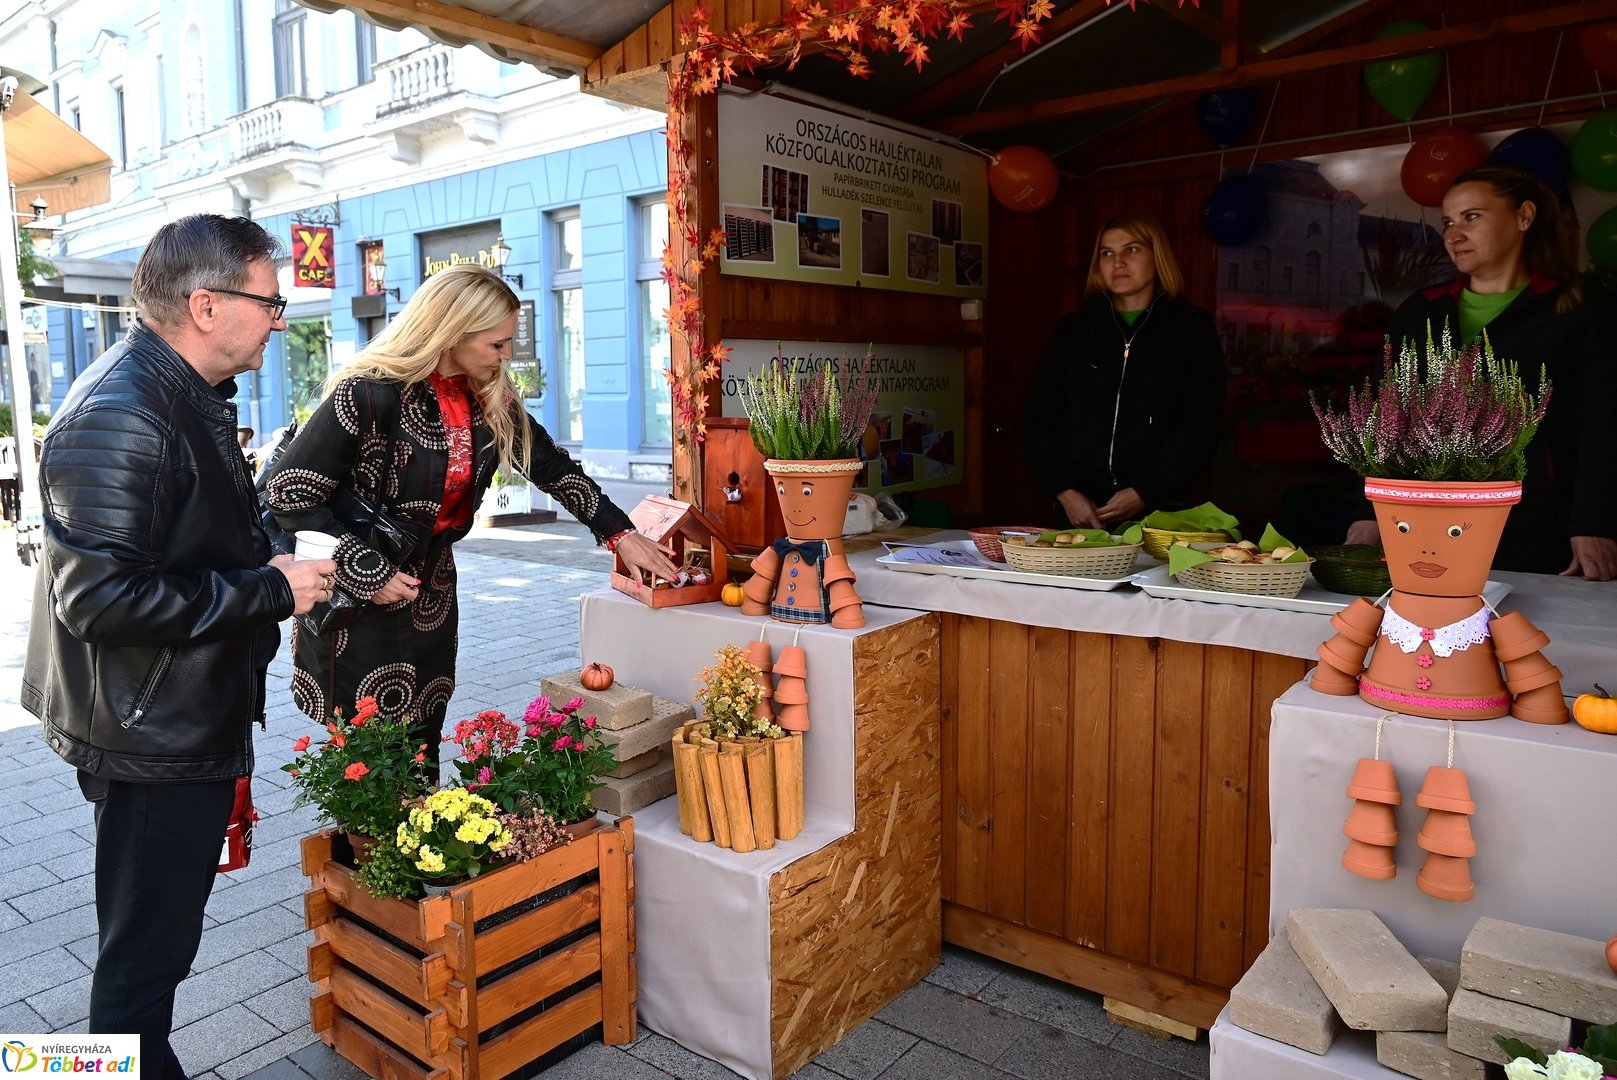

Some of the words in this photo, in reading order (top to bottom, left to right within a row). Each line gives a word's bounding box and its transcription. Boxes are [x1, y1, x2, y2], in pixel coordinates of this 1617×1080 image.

[796, 119, 867, 151] ORSZÁGOS
[870, 137, 943, 171] HAJLÉKTALAN
[766, 133, 909, 182] KÖZFOGLALKOZTATÁSI
[912, 169, 961, 196] PROGRAM
[821, 185, 860, 202] HULLADÉK
[861, 193, 892, 208] SZELENCE
[834, 172, 882, 192] PAPÍRBRIKETT
[883, 183, 914, 198] GYÁRTÁSA
[298, 230, 329, 267] X
[867, 376, 950, 393] MNTAPROGRAM
